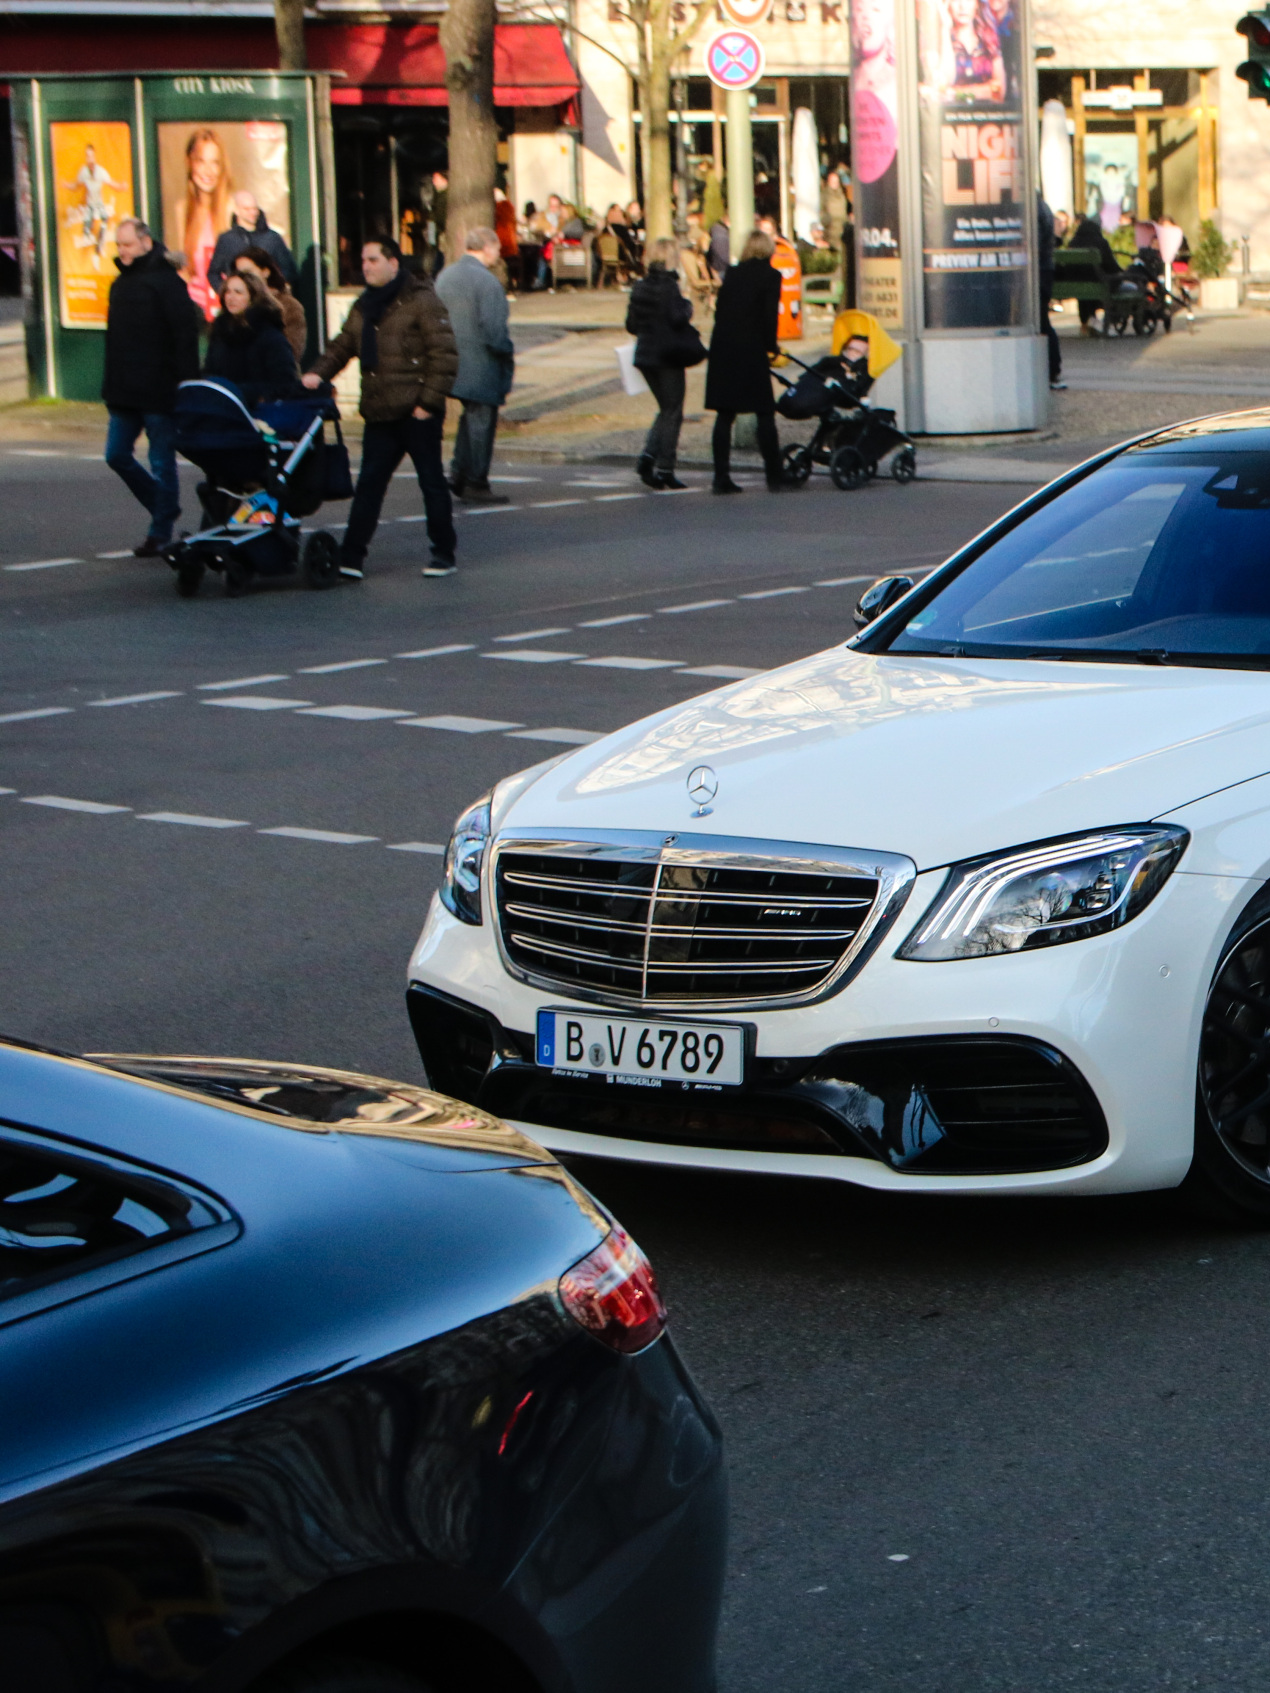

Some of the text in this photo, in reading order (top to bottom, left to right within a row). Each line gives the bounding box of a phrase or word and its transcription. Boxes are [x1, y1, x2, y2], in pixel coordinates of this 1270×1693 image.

[174, 76, 255, 93] CITY KIOSK
[932, 253, 978, 268] PREVIEW
[543, 1044, 550, 1057] D
[566, 1021, 724, 1074] B V 6789
[616, 1074, 662, 1087] MUNDERLOH
